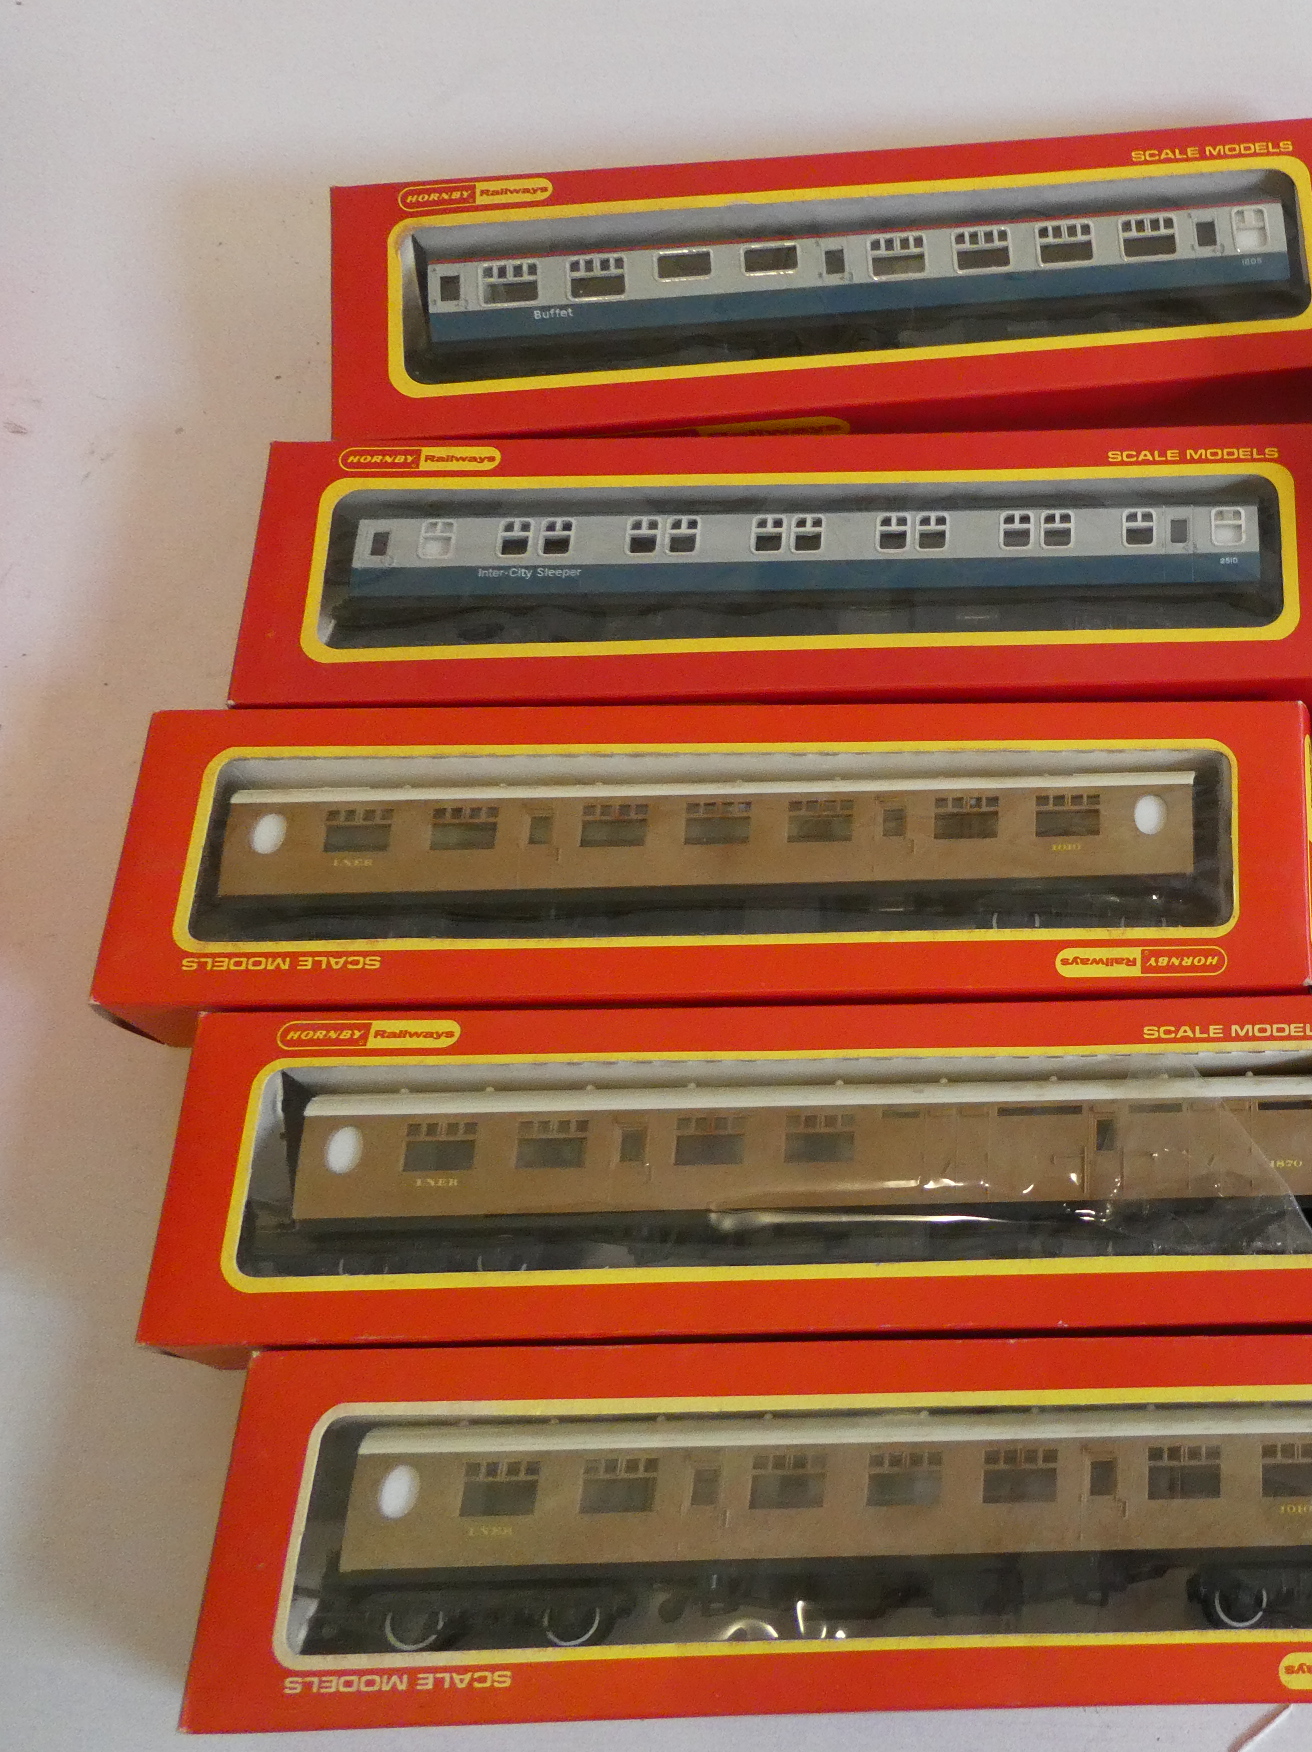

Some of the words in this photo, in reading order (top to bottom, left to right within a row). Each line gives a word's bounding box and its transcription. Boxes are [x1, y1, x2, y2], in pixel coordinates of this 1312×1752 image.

[1131, 147, 1199, 162] SCALE
[1205, 141, 1294, 157] MODELS
[406, 190, 471, 203] HORNBY
[479, 185, 549, 197] Railways
[533, 307, 574, 320] Buffet
[347, 455, 415, 463] HORNBY
[424, 454, 496, 464] Railways
[1107, 449, 1180, 462] SCALE
[1186, 447, 1279, 460] MODELS
[478, 567, 533, 580] Inter-City
[536, 566, 582, 579] Sleeper
[181, 957, 290, 971] MODELS
[297, 956, 382, 970] SCALE
[1060, 956, 1137, 967] Railways
[1145, 956, 1219, 967] HORNBY
[287, 1029, 363, 1040] HORNBY
[373, 1029, 455, 1040] Railways
[1143, 1025, 1224, 1039] SCALE
[283, 1674, 408, 1694] MODELS
[416, 1671, 512, 1690] SCALE
